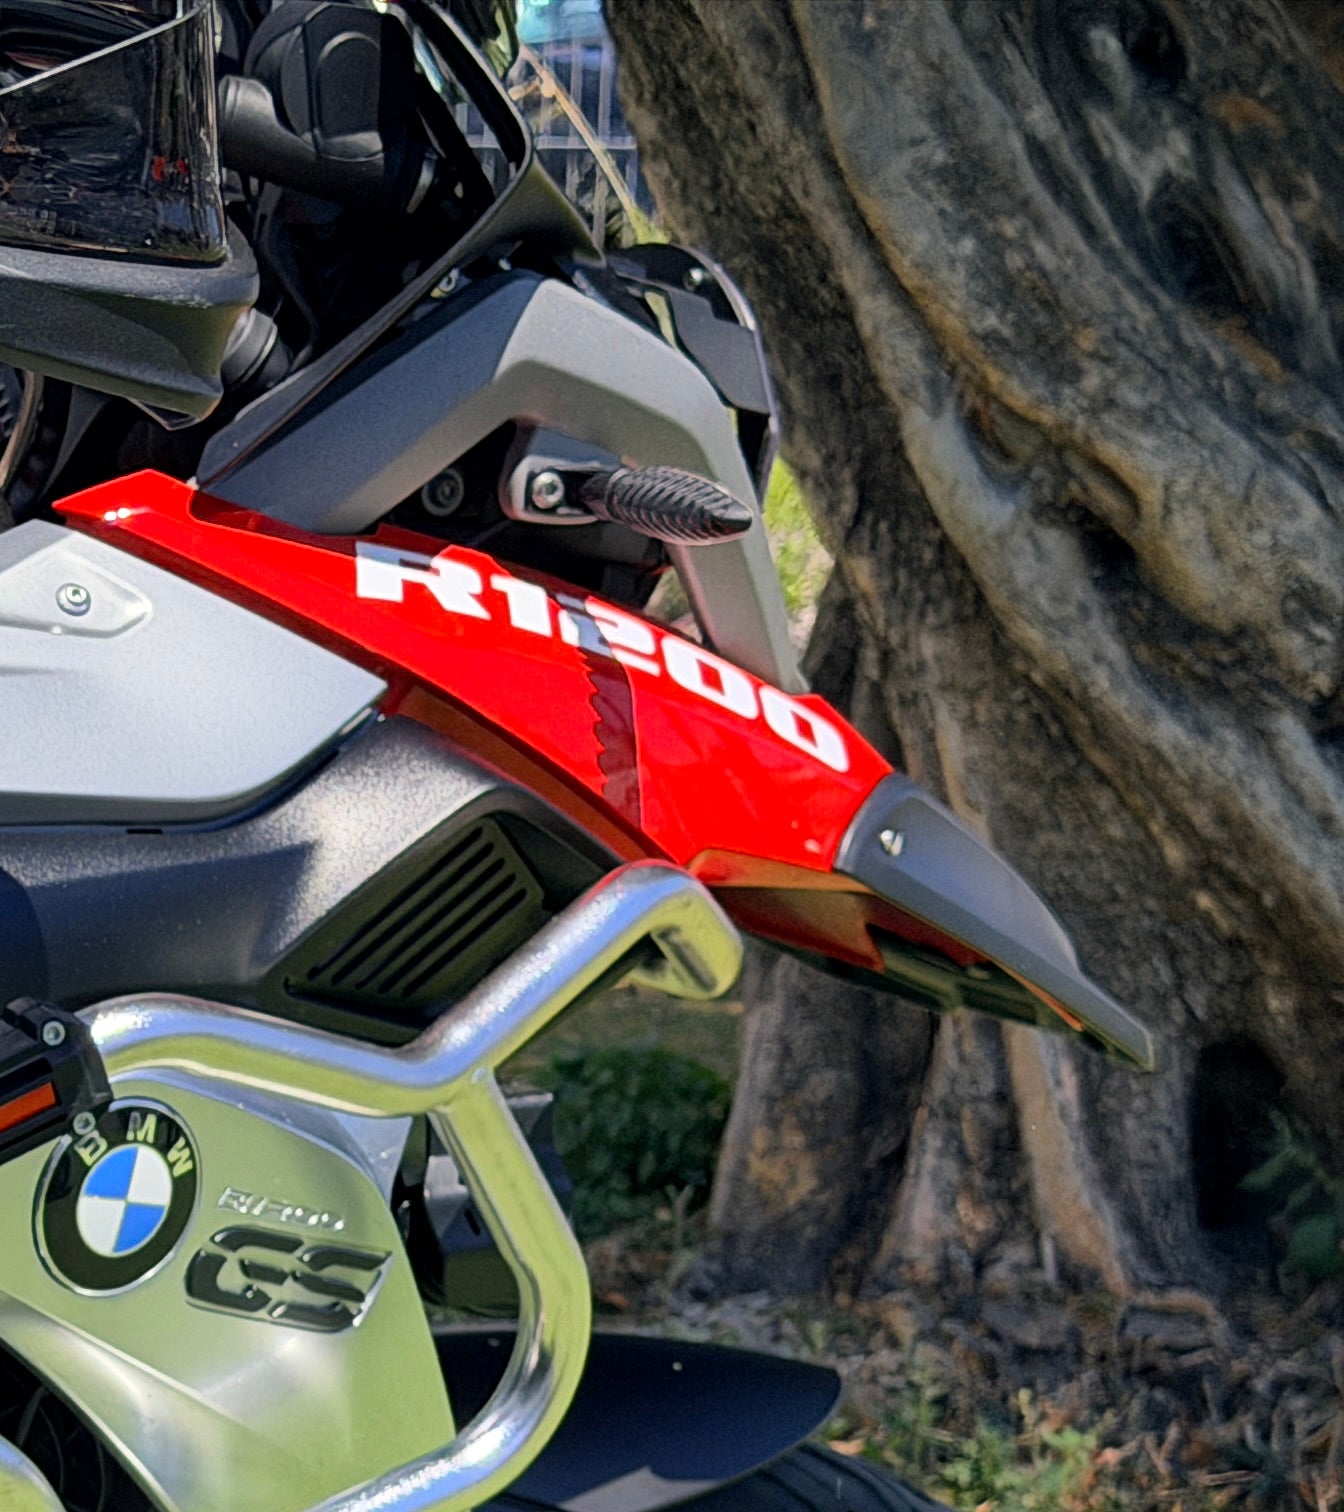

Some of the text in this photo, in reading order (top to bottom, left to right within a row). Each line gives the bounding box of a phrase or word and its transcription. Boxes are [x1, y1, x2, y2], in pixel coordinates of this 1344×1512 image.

[355, 541, 850, 774] R1200
[73, 1111, 194, 1178] BMW
[183, 1223, 393, 1335] GS
